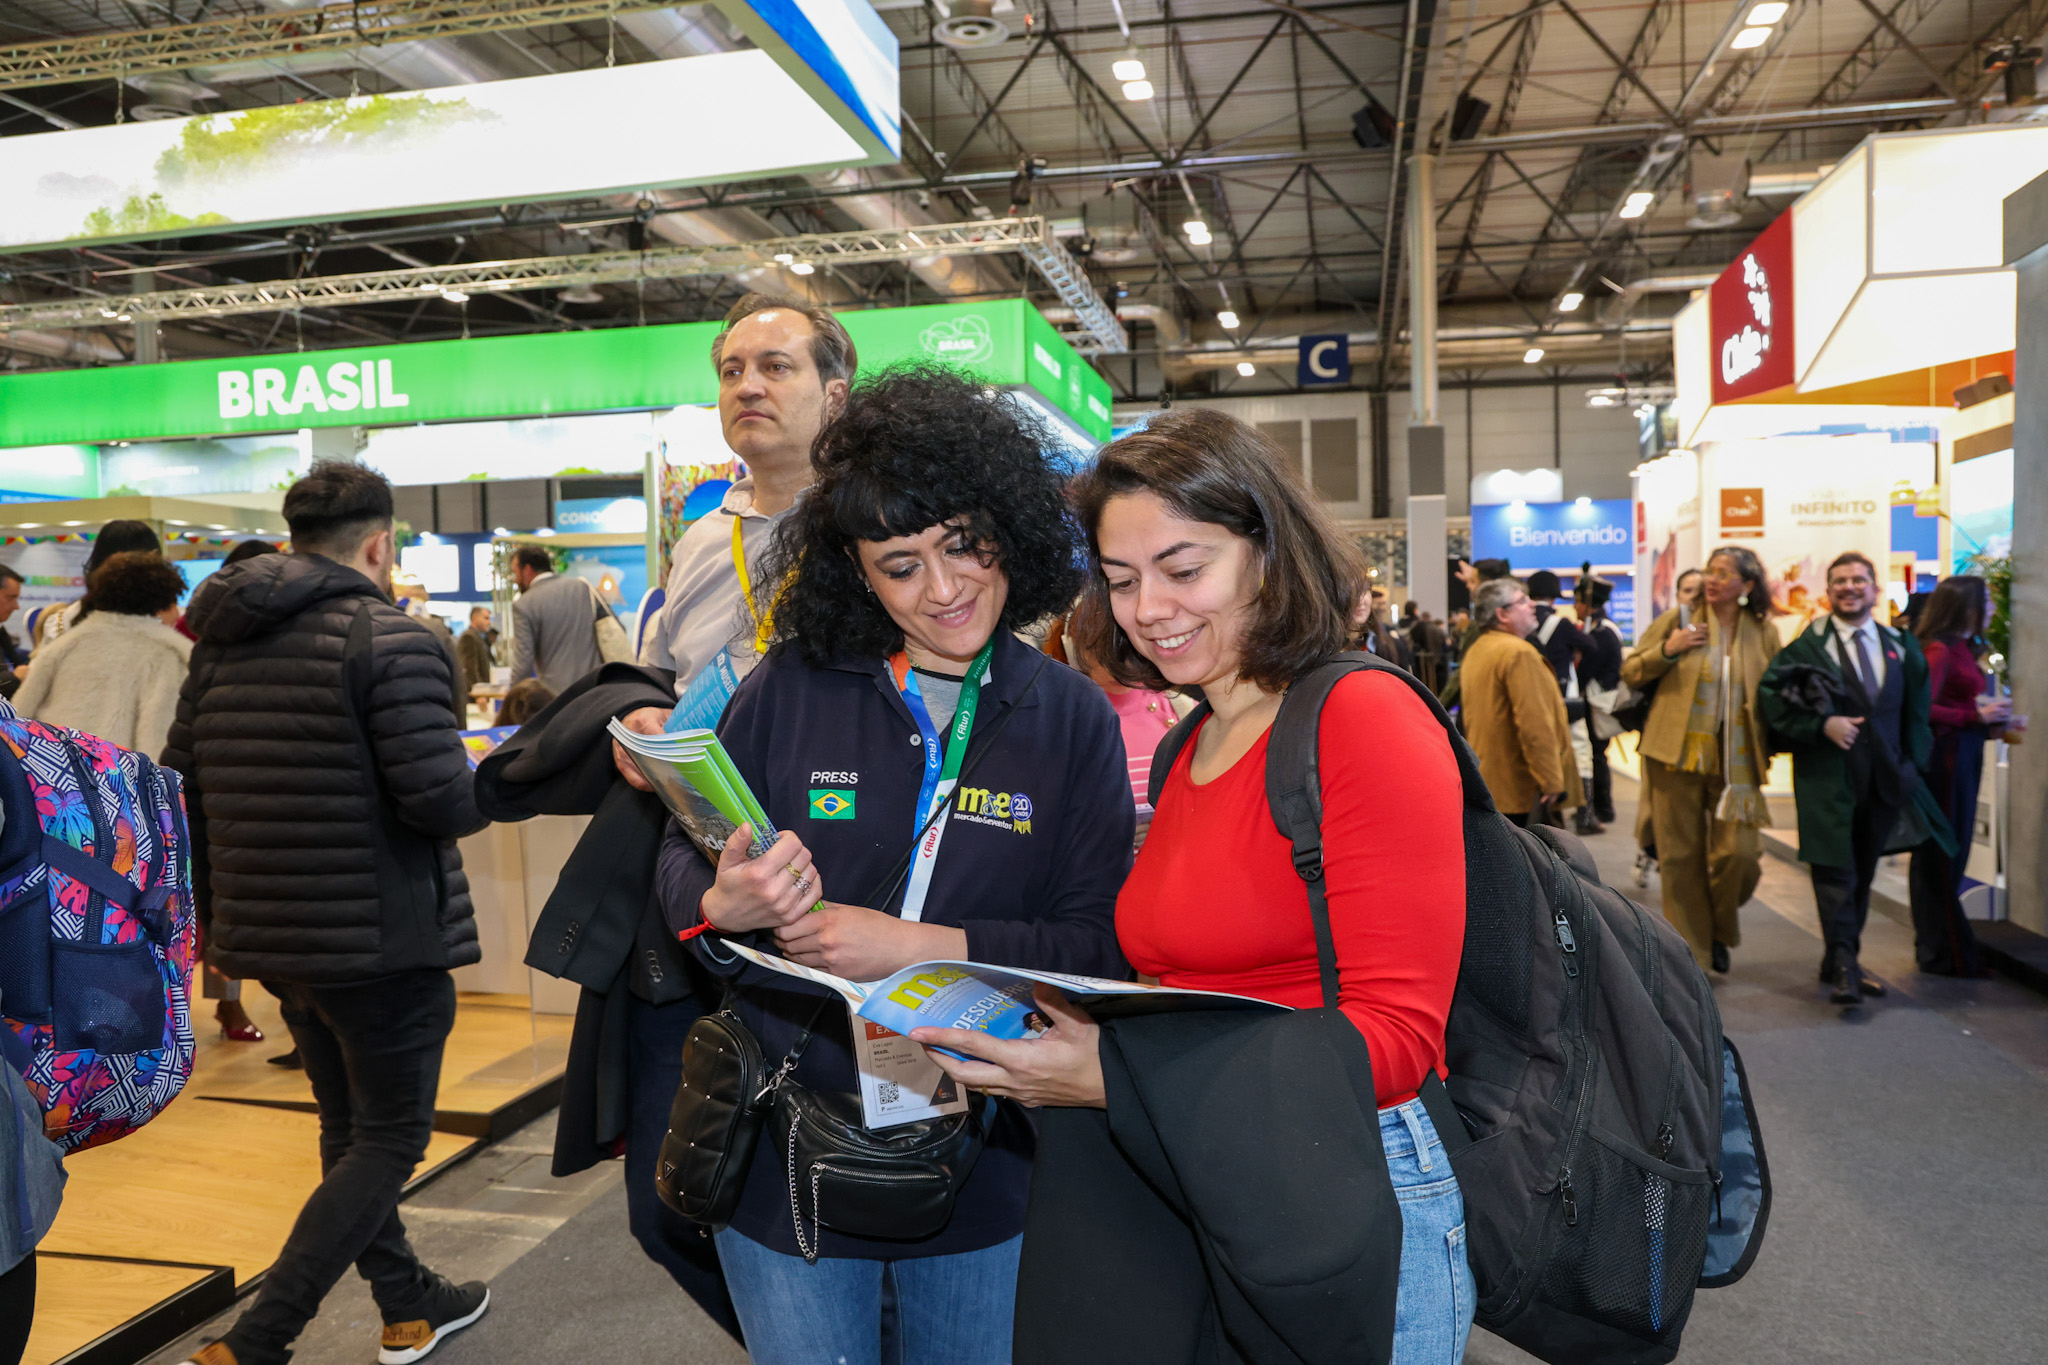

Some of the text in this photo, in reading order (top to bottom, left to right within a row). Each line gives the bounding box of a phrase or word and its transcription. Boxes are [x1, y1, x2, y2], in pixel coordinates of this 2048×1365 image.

[938, 339, 976, 351] BRASIL
[1309, 340, 1338, 378] C
[218, 359, 409, 419] BRASIL
[1791, 501, 1877, 515] INFINITO
[1510, 525, 1627, 547] Bienvenido
[810, 771, 859, 784] PRESS
[957, 786, 1012, 818] m&e
[1014, 798, 1029, 811] 20
[953, 813, 1013, 830] mercado&eventos
